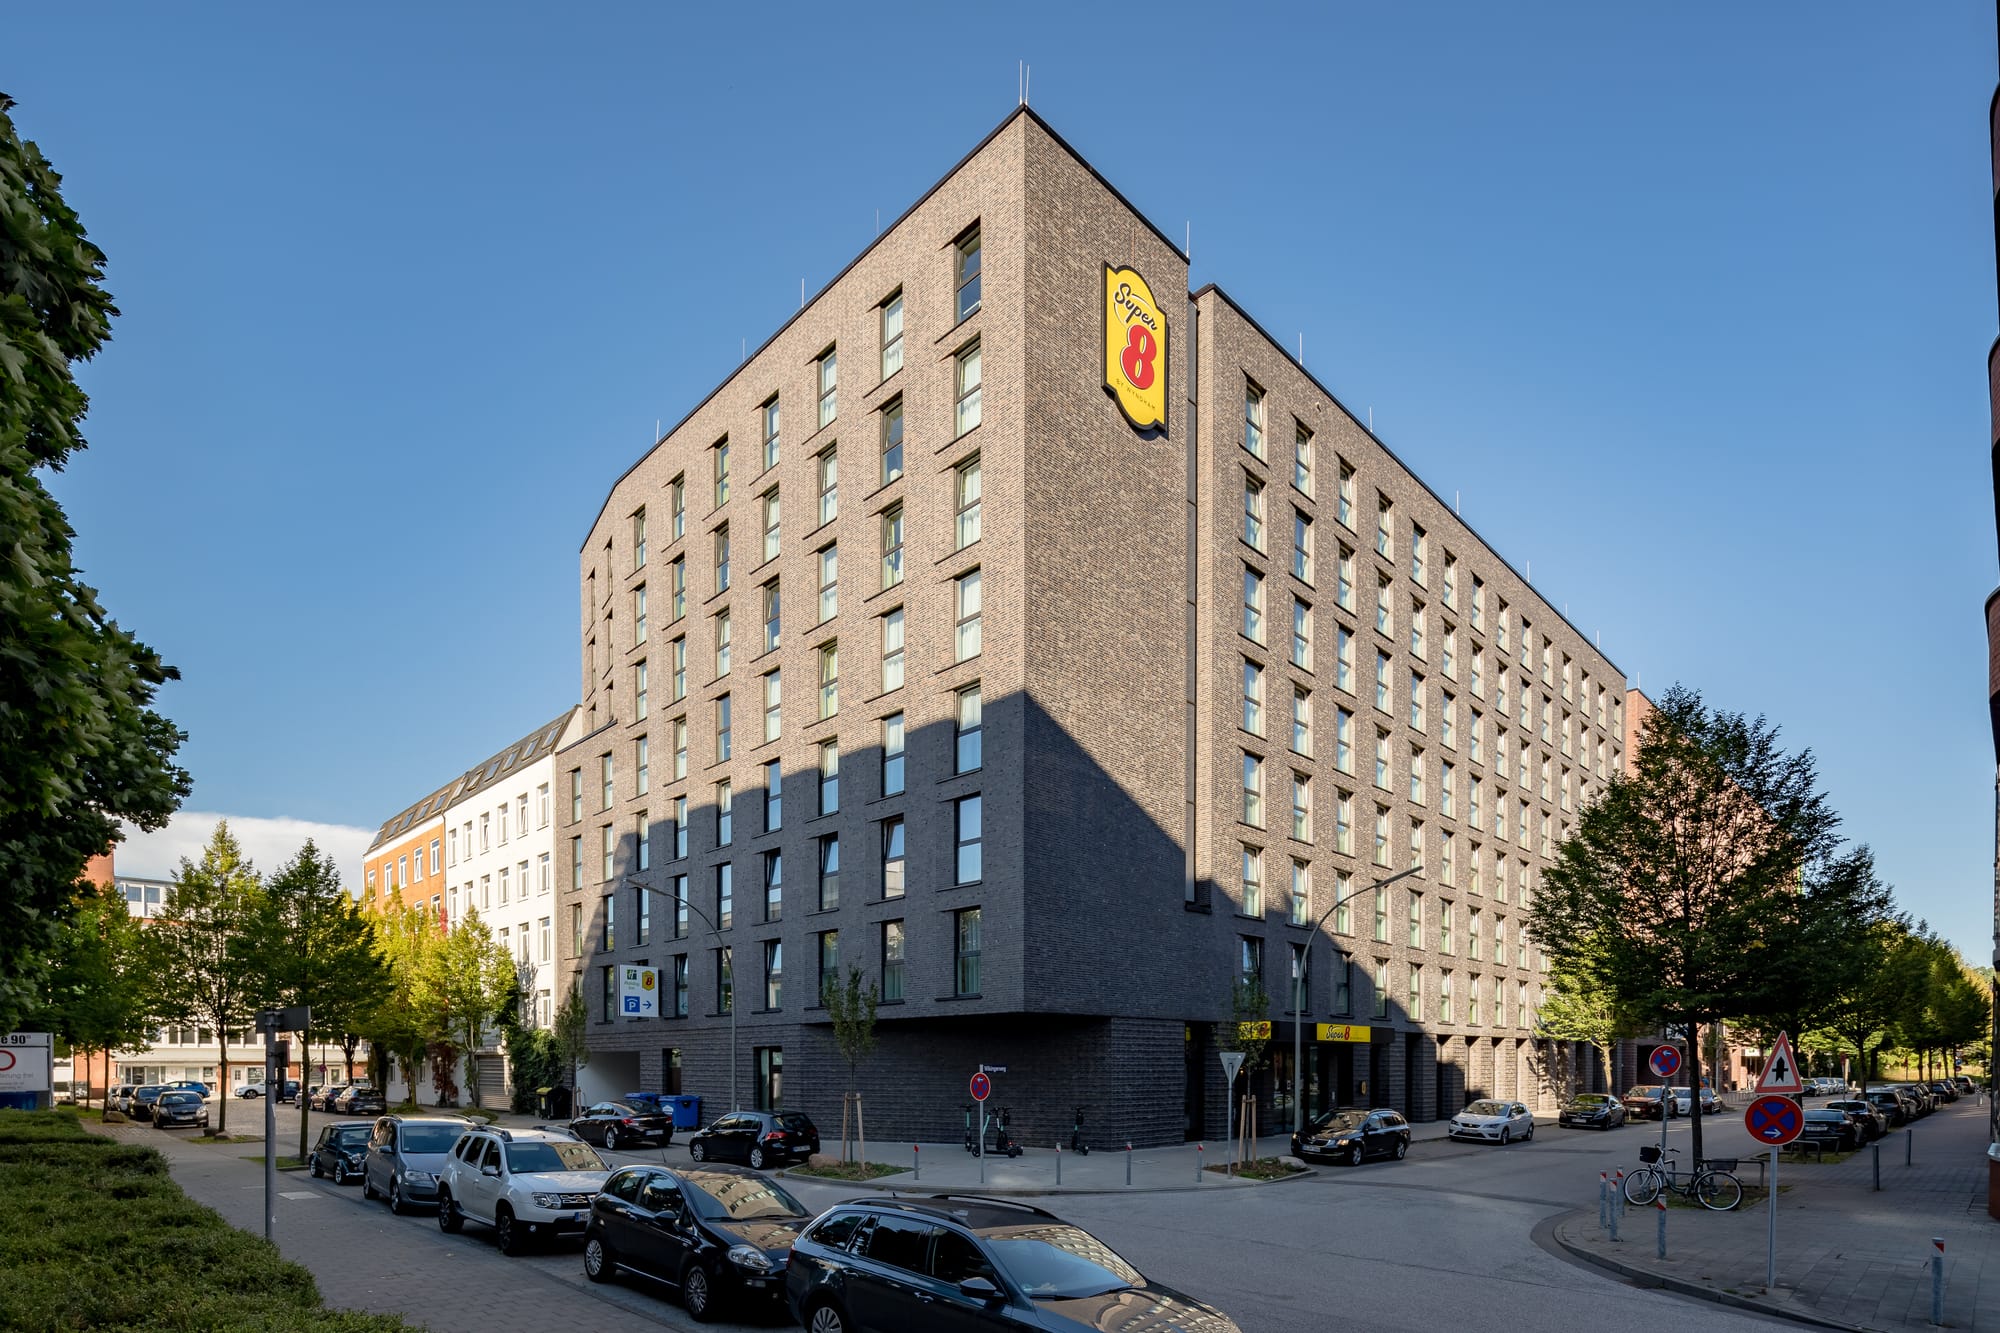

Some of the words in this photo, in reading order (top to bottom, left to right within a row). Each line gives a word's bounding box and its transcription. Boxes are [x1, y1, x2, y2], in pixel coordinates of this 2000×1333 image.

[1114, 282, 1158, 331] Super
[1120, 324, 1157, 390] 8
[1326, 1024, 1344, 1041] Super
[1344, 1025, 1350, 1041] 8
